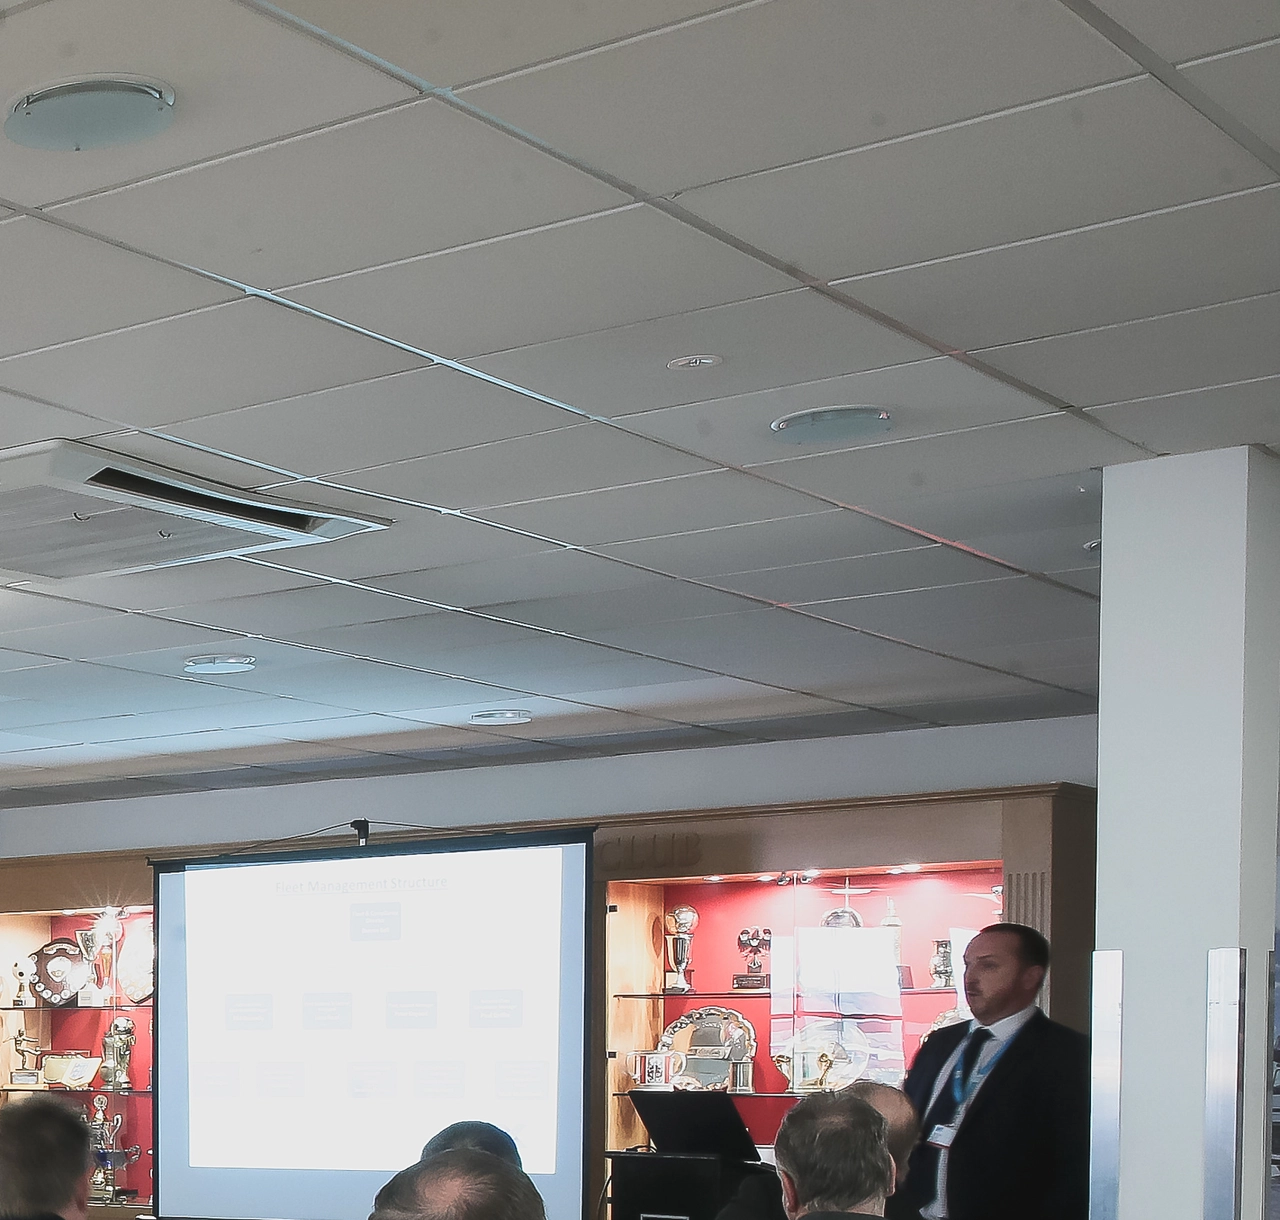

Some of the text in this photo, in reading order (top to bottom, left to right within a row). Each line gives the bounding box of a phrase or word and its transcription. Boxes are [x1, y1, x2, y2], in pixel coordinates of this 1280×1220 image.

[596, 832, 704, 872] CLUB
[275, 876, 447, 894] Fleet Management Structure
